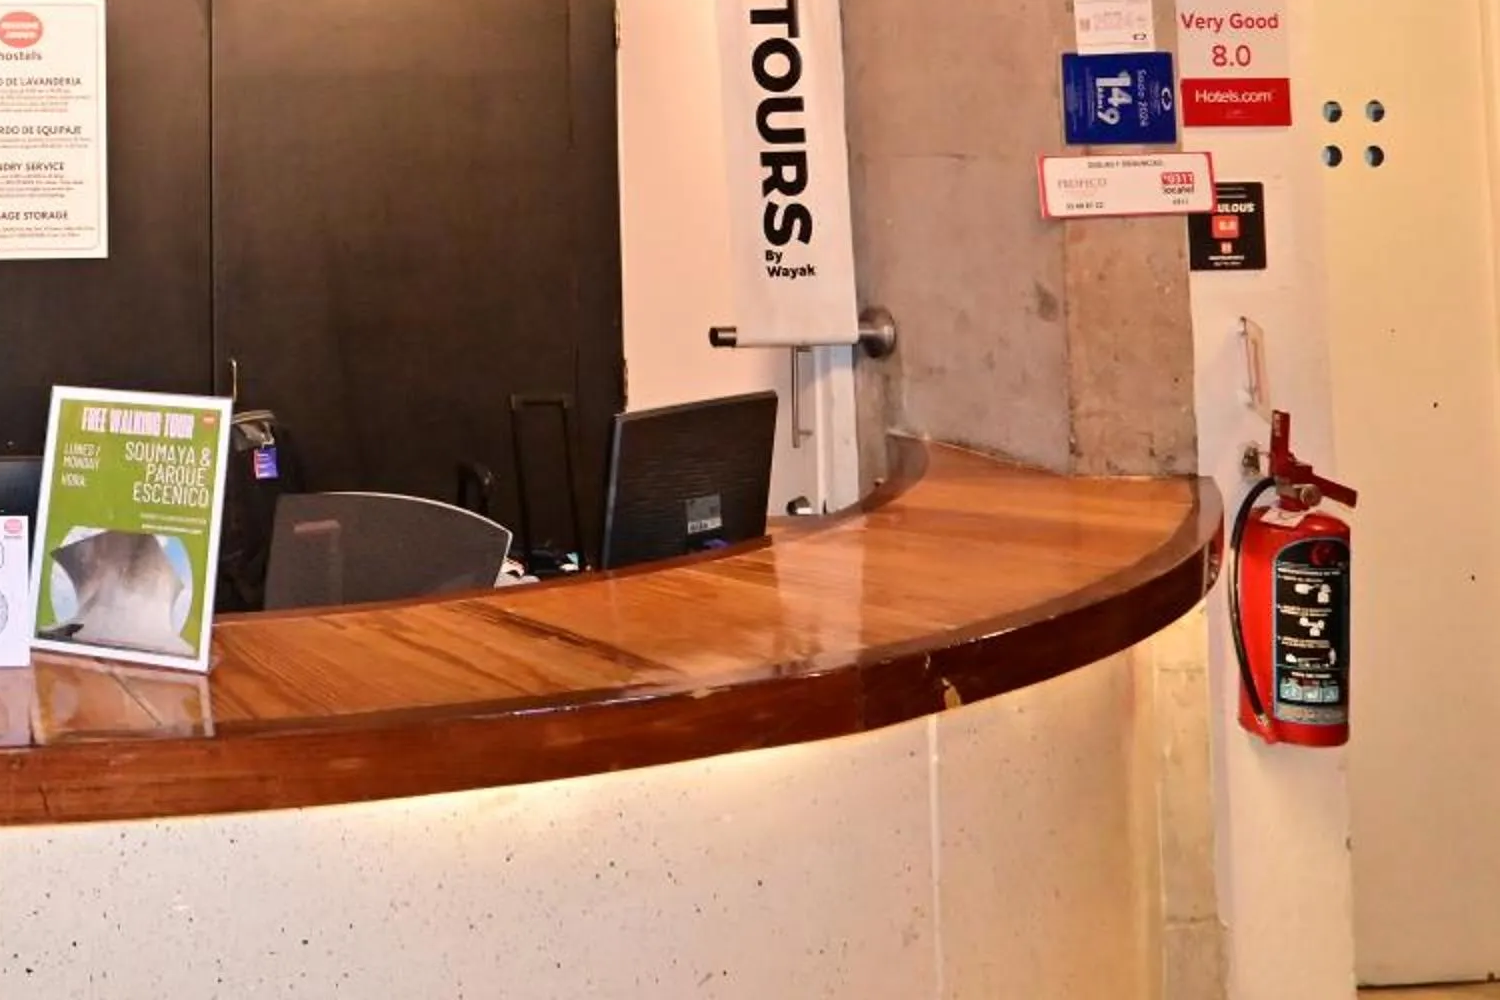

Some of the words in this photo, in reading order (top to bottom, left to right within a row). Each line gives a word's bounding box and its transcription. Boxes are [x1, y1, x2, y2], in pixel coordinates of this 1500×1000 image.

[1180, 12, 1224, 33] Very
[1229, 12, 1279, 29] Good
[1212, 44, 1251, 67] 8.0
[1195, 89, 1271, 104] Hotels.com
[25, 162, 66, 172] SERVICE
[1216, 202, 1255, 213] ULOUS
[23, 211, 69, 221] STORAGE
[765, 249, 782, 264] By
[767, 264, 816, 280] Wayak
[81, 406, 109, 433] FREE
[109, 407, 163, 438] WALKING
[163, 411, 195, 440] TOUR
[125, 441, 196, 466] SOUMAYA
[199, 447, 212, 467] &
[145, 463, 206, 488] PARQUE
